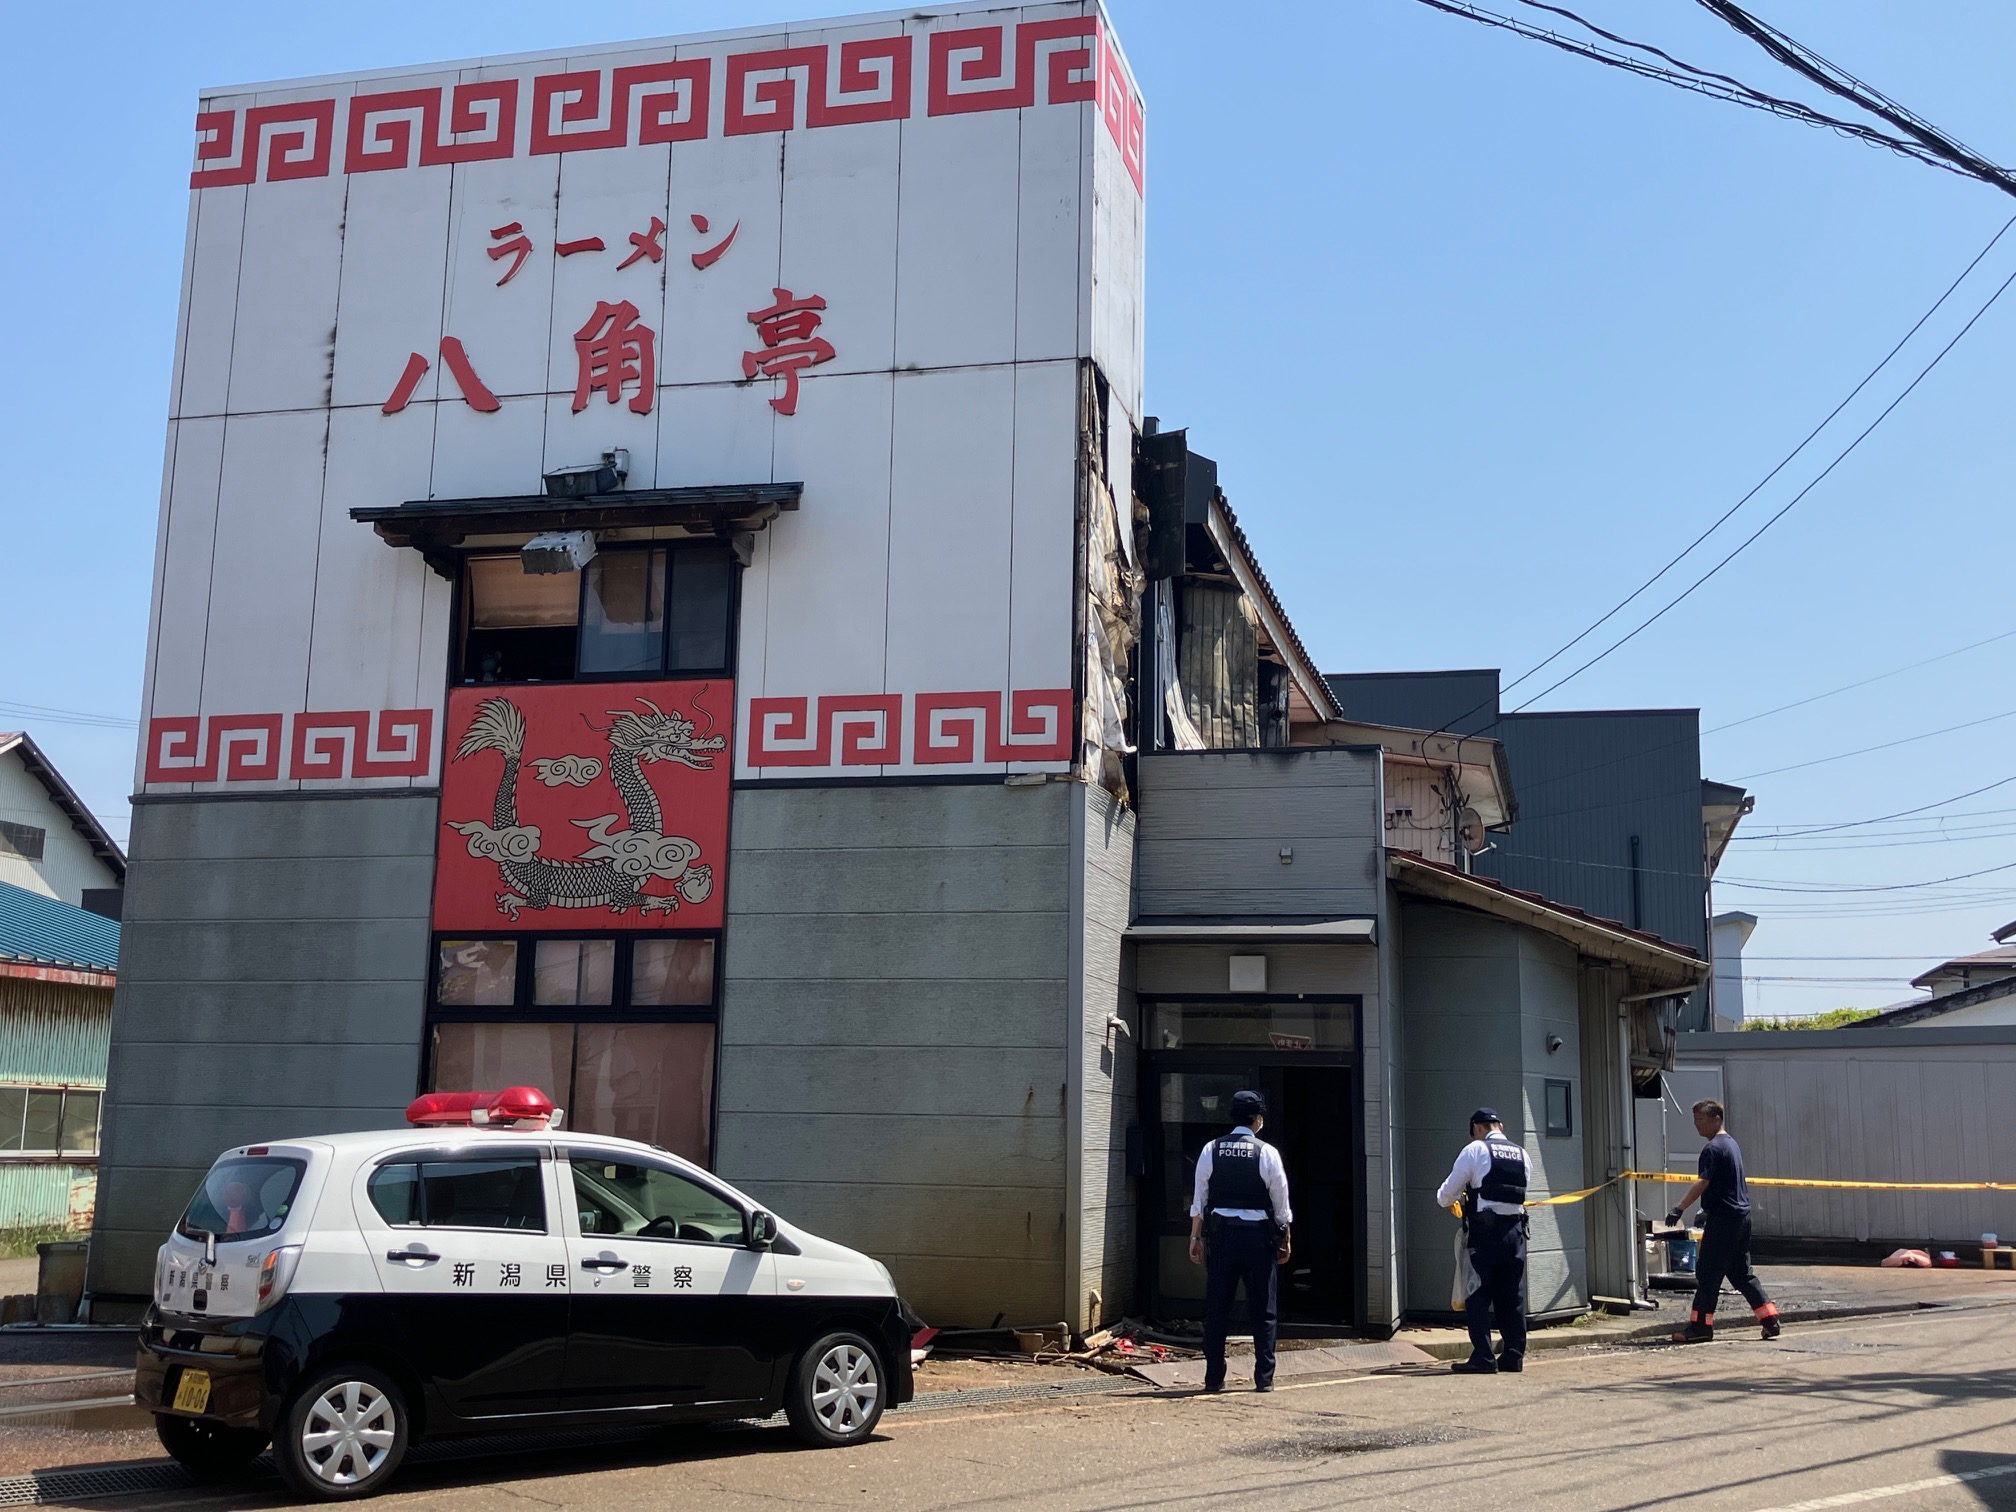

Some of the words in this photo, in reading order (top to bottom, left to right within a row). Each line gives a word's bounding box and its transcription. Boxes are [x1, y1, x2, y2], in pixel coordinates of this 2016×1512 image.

[487, 214, 740, 287] ラーメン
[381, 288, 837, 416] 八角亭
[1218, 1149, 1254, 1158] POLICE
[1492, 1150, 1522, 1161] POLICE
